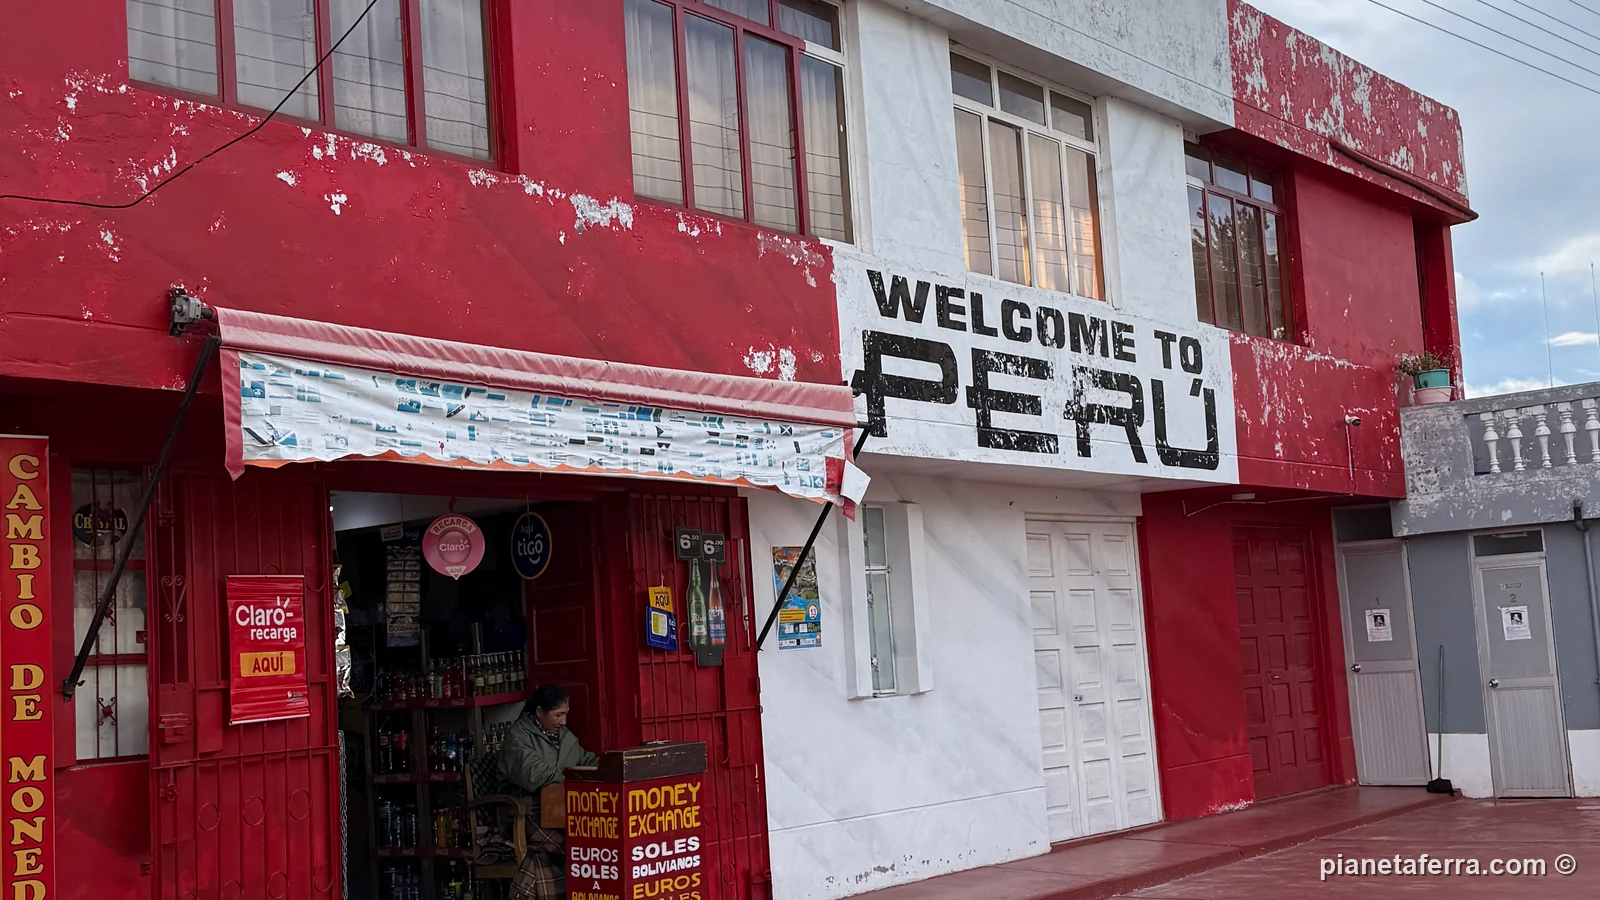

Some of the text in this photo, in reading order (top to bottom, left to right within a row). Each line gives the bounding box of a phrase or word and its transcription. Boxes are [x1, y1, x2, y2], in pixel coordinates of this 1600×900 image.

[866, 270, 1203, 374] WELCOME TO
[851, 329, 1220, 471] PERÚ
[74, 512, 126, 530] CRSTAL
[433, 516, 475, 534] RECARGA
[5, 454, 44, 630] CAMBIO
[439, 542, 465, 551] Claro
[1510, 593, 1517, 602] 2
[235, 604, 286, 627] Claro
[250, 627, 296, 642] recarga
[252, 652, 284, 673] AQUÍ
[9, 664, 45, 721] DE
[567, 790, 619, 814] MONEY
[628, 781, 701, 813] MONEY
[567, 815, 619, 839] EXCHANGE
[628, 805, 701, 838] EXCHANGE
[570, 847, 619, 863] EUROS
[631, 836, 700, 862] SOLES
[570, 863, 619, 880] SOLES
[632, 855, 701, 880] BOLIVIANOS
[592, 880, 601, 890] A
[633, 872, 701, 900] EUROS
